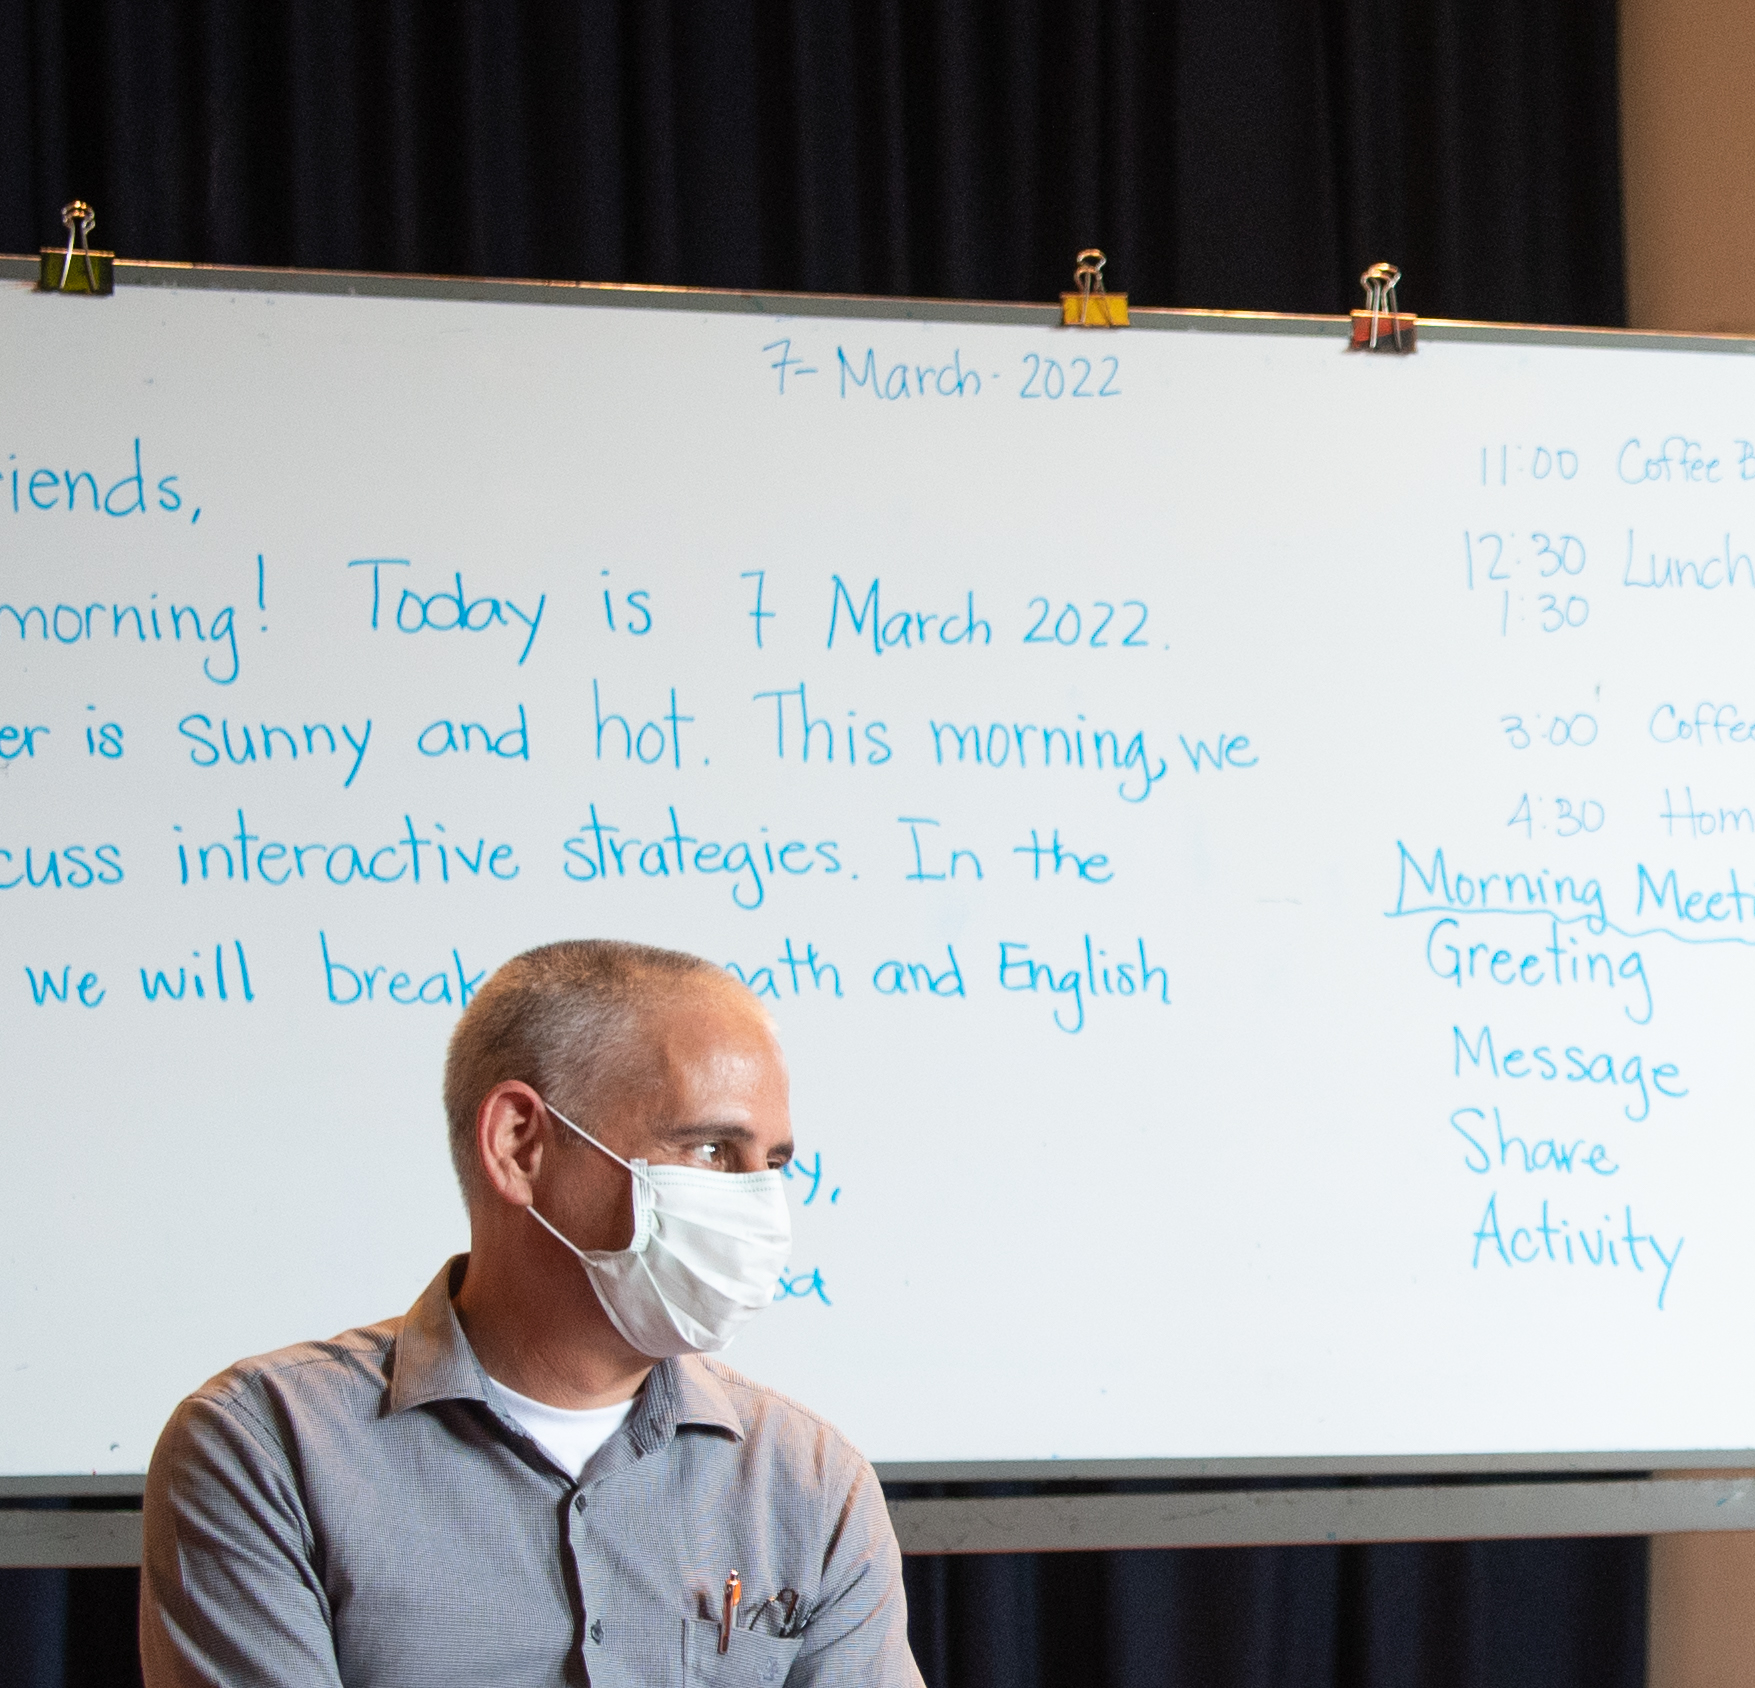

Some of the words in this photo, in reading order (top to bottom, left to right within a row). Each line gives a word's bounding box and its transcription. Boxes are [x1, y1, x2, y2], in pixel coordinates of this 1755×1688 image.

[1019, 353, 1120, 399] 2022
[0, 437, 202, 525] iends,
[1482, 446, 1577, 484] 11:00
[1618, 436, 1719, 483] Coffee
[1465, 531, 1586, 589] 12:30
[1623, 529, 1755, 589] Lunch
[347, 557, 547, 667] Today
[600, 569, 653, 636] is
[740, 569, 776, 649] 7
[826, 573, 993, 657] March
[1022, 596, 1169, 649] 2022.
[1503, 591, 1588, 634] 1:30
[85, 704, 125, 760] is
[177, 712, 373, 789] sunny
[416, 703, 530, 762] and
[592, 678, 710, 770] hot.
[753, 681, 893, 766] This
[929, 714, 1167, 802] morning,
[1178, 733, 1259, 773] we
[1502, 713, 1597, 749] 3:00
[172, 807, 520, 886] interactive
[562, 802, 858, 911] strategies.
[897, 816, 984, 883] In
[1012, 828, 1114, 885] the
[1508, 793, 1604, 837] 4:30
[1397, 839, 1607, 935] Morning
[24, 964, 106, 1009] we
[139, 939, 255, 1004] will
[318, 930, 485, 1010] break
[872, 943, 966, 999] and
[998, 932, 1171, 1035] English
[1427, 918, 1653, 1025] Greeting
[1452, 1025, 1689, 1122] Message
[1449, 1106, 1619, 1176] Share
[1471, 1191, 1684, 1310] Activity
